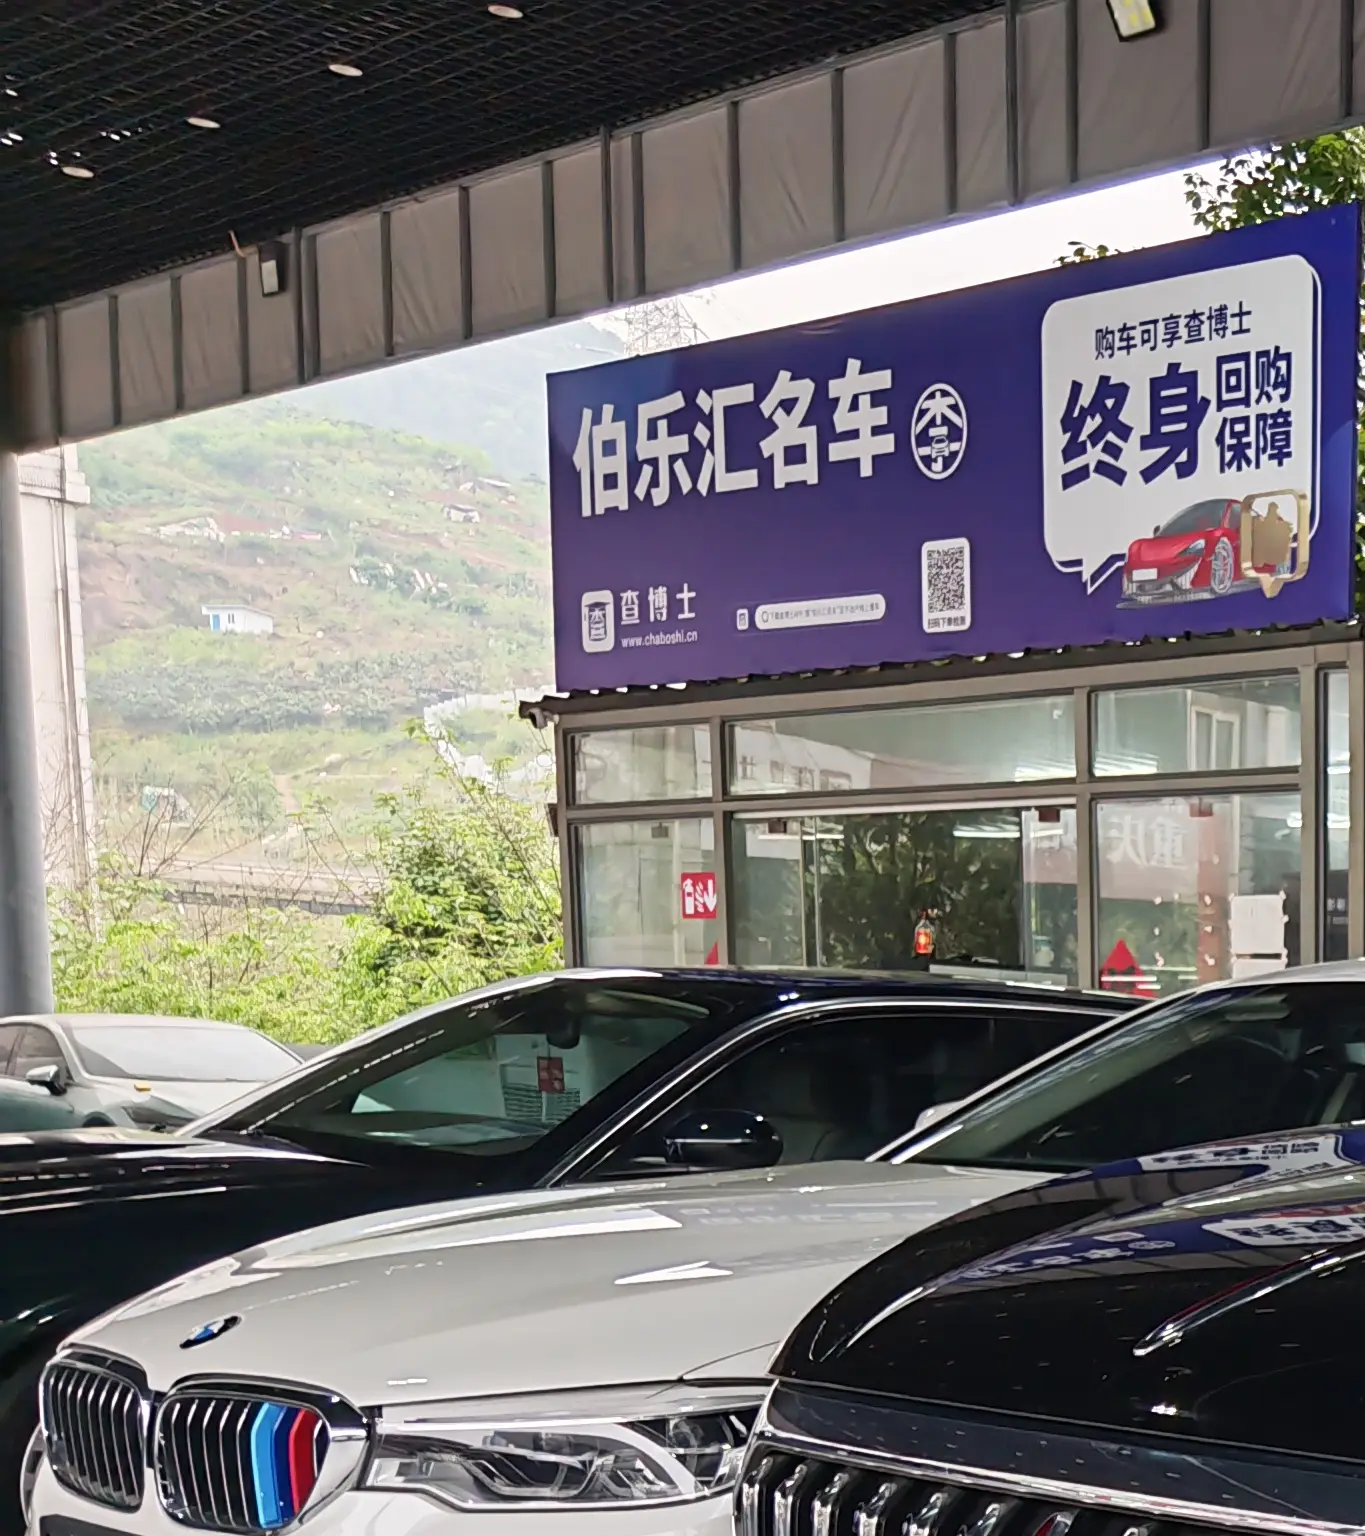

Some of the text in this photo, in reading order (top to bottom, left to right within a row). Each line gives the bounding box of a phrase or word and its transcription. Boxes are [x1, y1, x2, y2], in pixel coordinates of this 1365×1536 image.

[1094, 300, 1253, 361] 购车可享查博士
[1216, 344, 1293, 412] 回购
[571, 357, 896, 518] 伯乐汇名车
[1059, 361, 1212, 491] 终身
[1214, 408, 1293, 475] 保障
[620, 582, 697, 625] 查博士
[621, 629, 698, 648] www.chaboshi.cn
